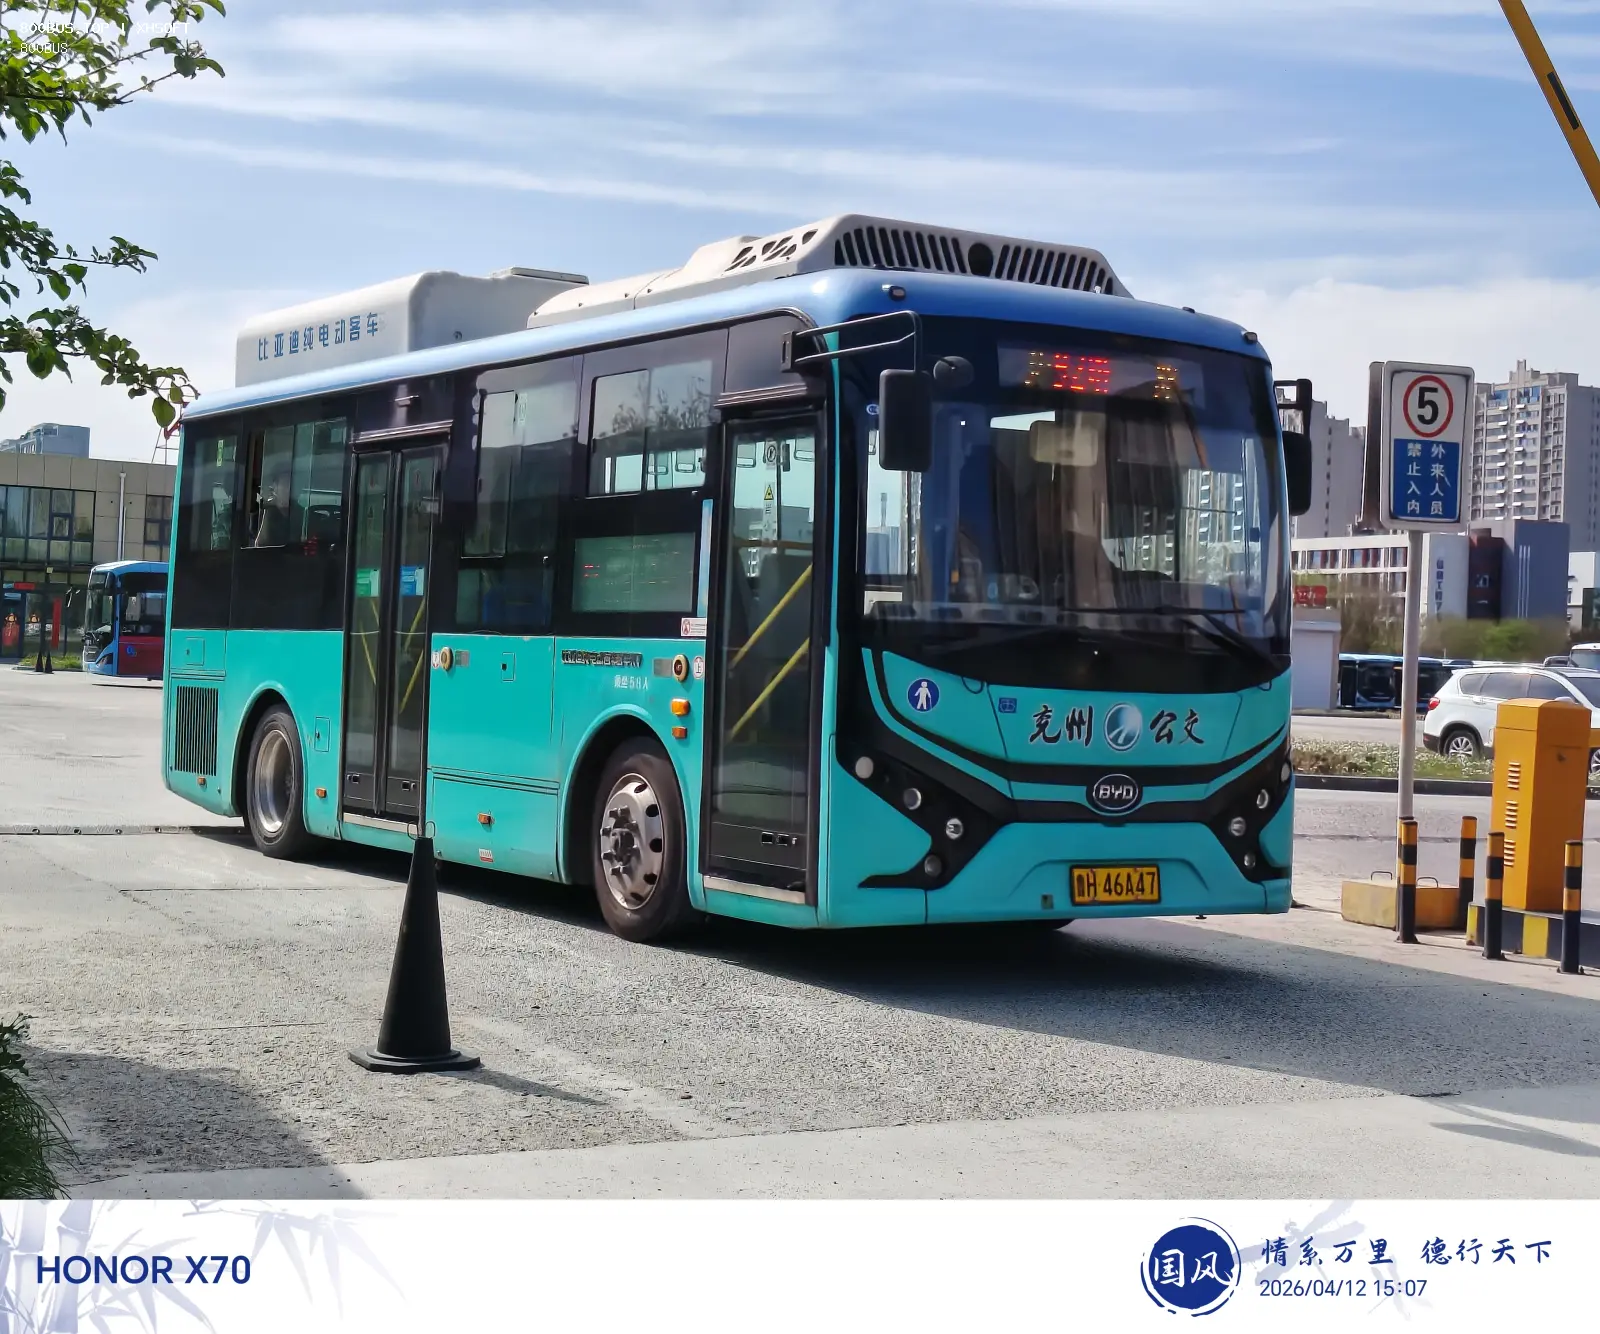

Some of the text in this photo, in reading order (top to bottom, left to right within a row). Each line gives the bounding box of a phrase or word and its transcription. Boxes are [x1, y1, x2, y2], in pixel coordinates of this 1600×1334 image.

[258, 312, 379, 361] 比亚迪纯电动客车
[1417, 387, 1439, 425] 5
[1406, 443, 1422, 515] 禁止入内
[1430, 443, 1446, 516] 外来人员
[1029, 704, 1205, 747] 兖州 公交
[1099, 784, 1134, 799] BYD
